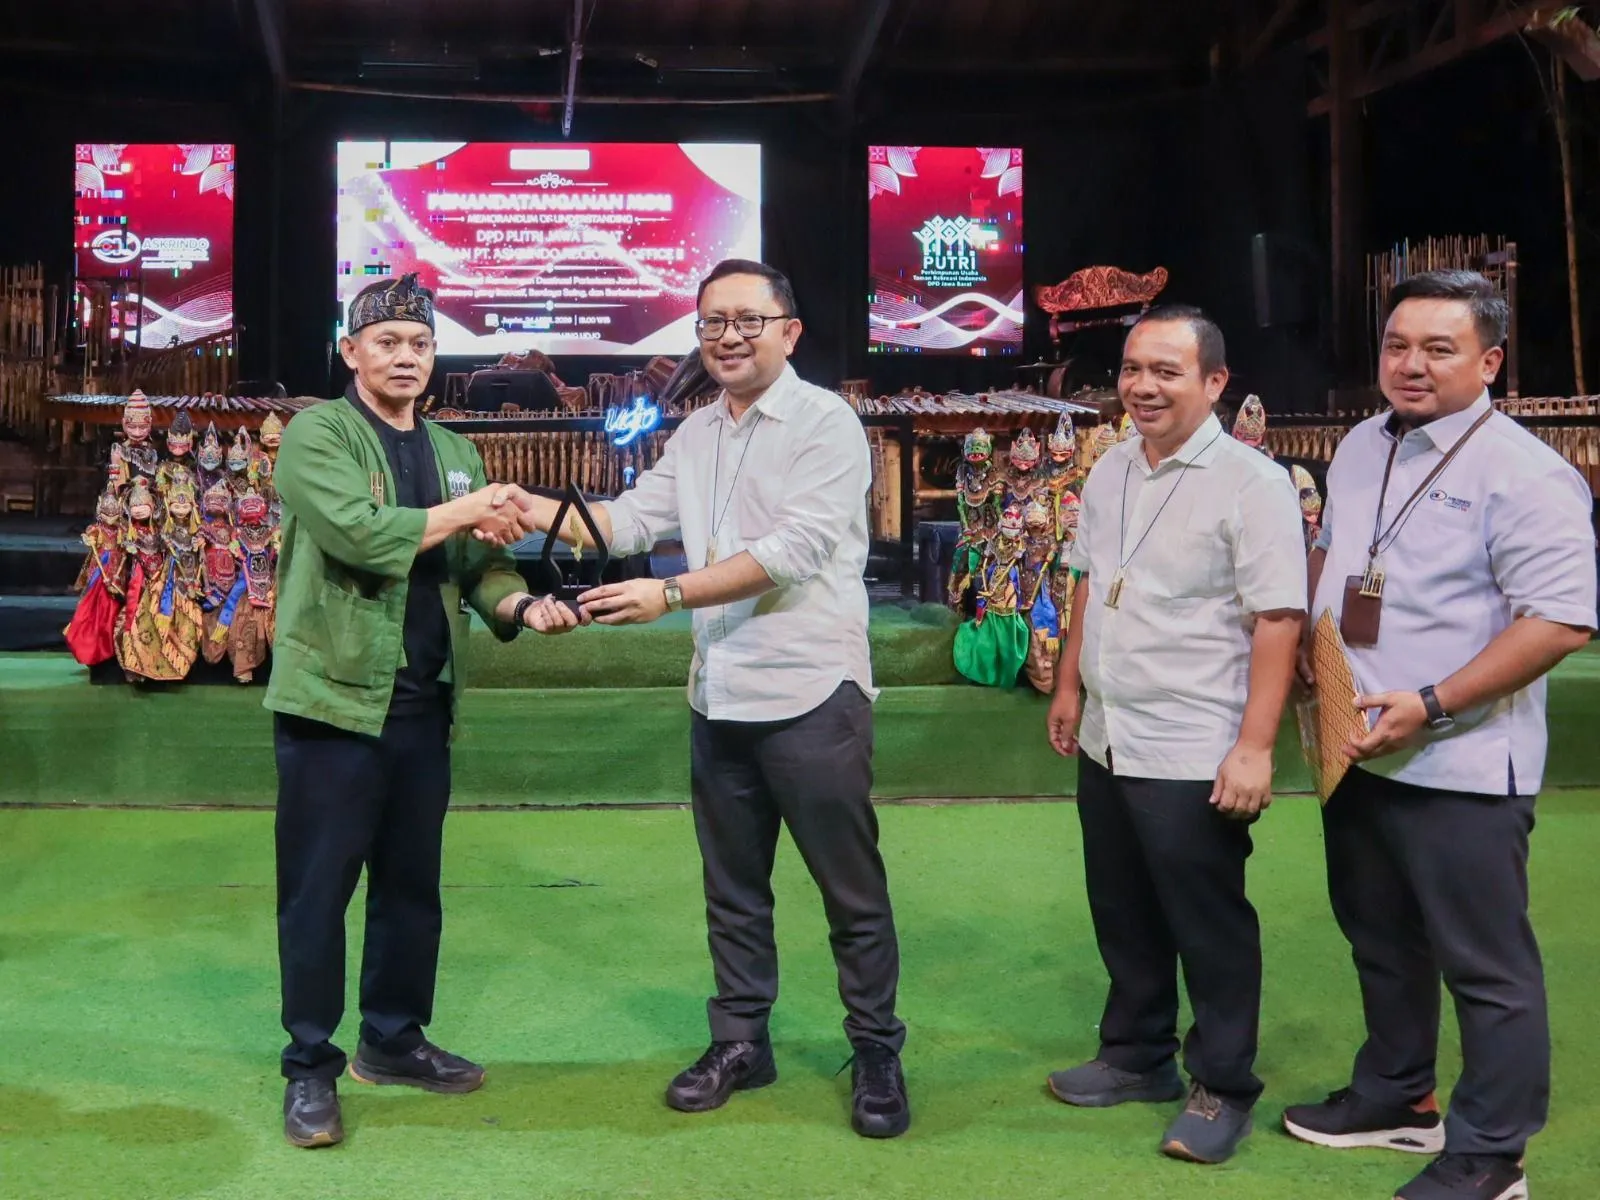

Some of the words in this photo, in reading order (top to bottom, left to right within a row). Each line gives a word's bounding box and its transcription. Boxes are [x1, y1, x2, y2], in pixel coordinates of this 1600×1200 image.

[476, 230, 504, 242] DPD
[506, 230, 544, 242] PUTRI
[142, 238, 209, 250] ASKRINDO
[474, 248, 492, 260] PT.
[923, 256, 976, 270] PUTRI
